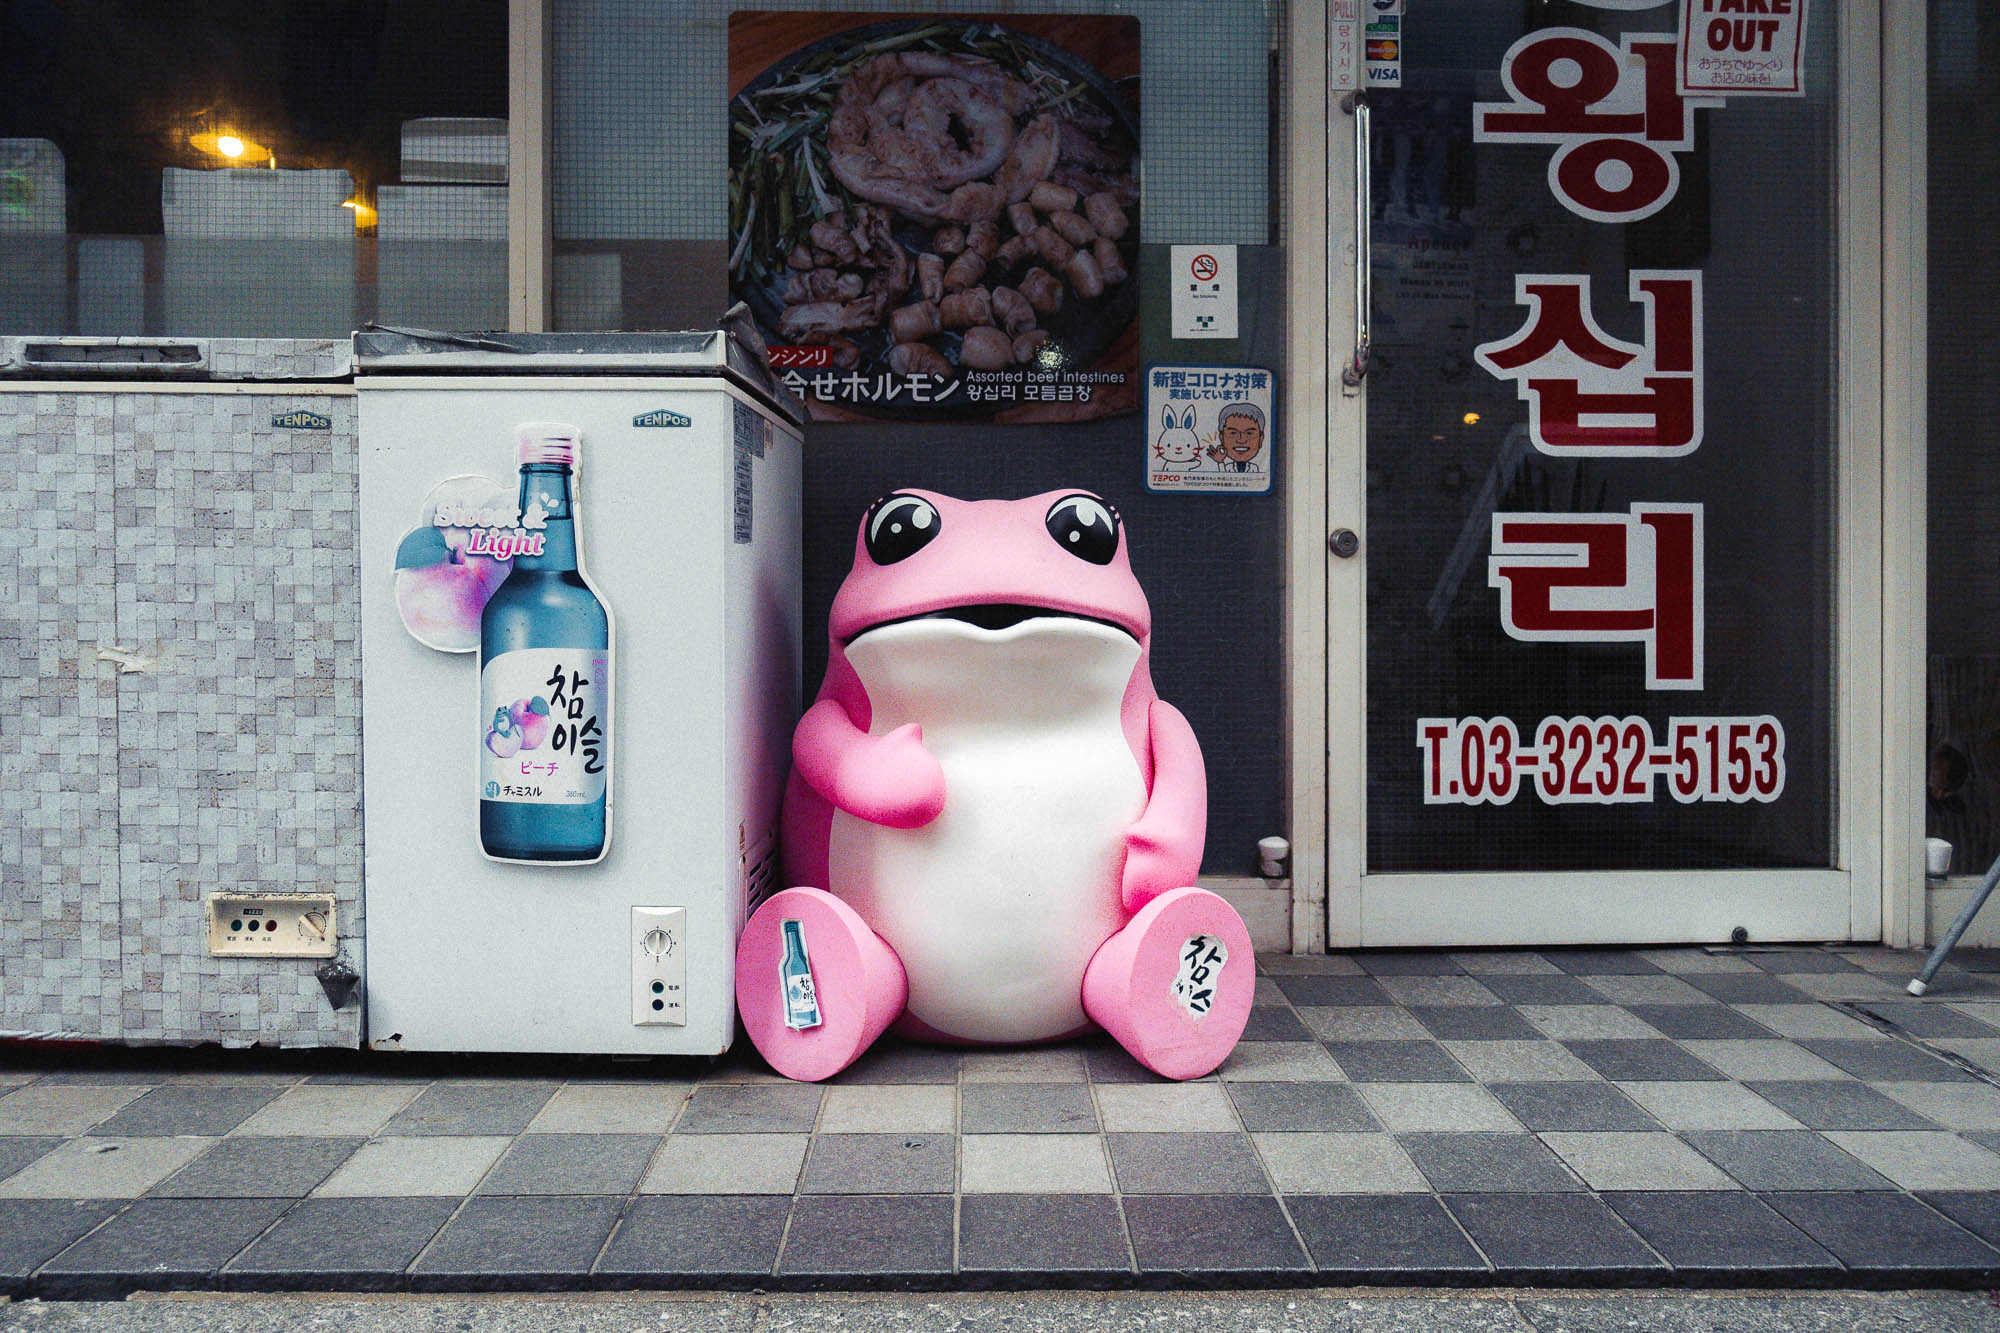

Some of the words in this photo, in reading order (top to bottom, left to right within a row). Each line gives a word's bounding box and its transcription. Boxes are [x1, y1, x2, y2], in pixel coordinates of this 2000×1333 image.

[1707, 18, 1779, 51] OUT
[1338, 24, 1351, 85] 당기시오
[1699, 58, 1783, 72] おうちでゆっくり
[1367, 68, 1399, 80] VISA
[966, 371, 1023, 383] Assorted
[1027, 371, 1060, 383] beef
[1063, 371, 1126, 383] intestines
[1153, 371, 1268, 389] 新型コロナ対策
[967, 384, 1017, 401] 왕십리
[1169, 388, 1250, 401] 実施しています!
[274, 412, 329, 427] TENPOS
[635, 412, 689, 426] TENPOS
[467, 528, 547, 561] Light
[546, 664, 604, 774] 참이슬
[1423, 723, 1779, 797] T.03-3232-5153
[521, 761, 559, 776] ピーチ
[503, 785, 543, 797] チャミスル
